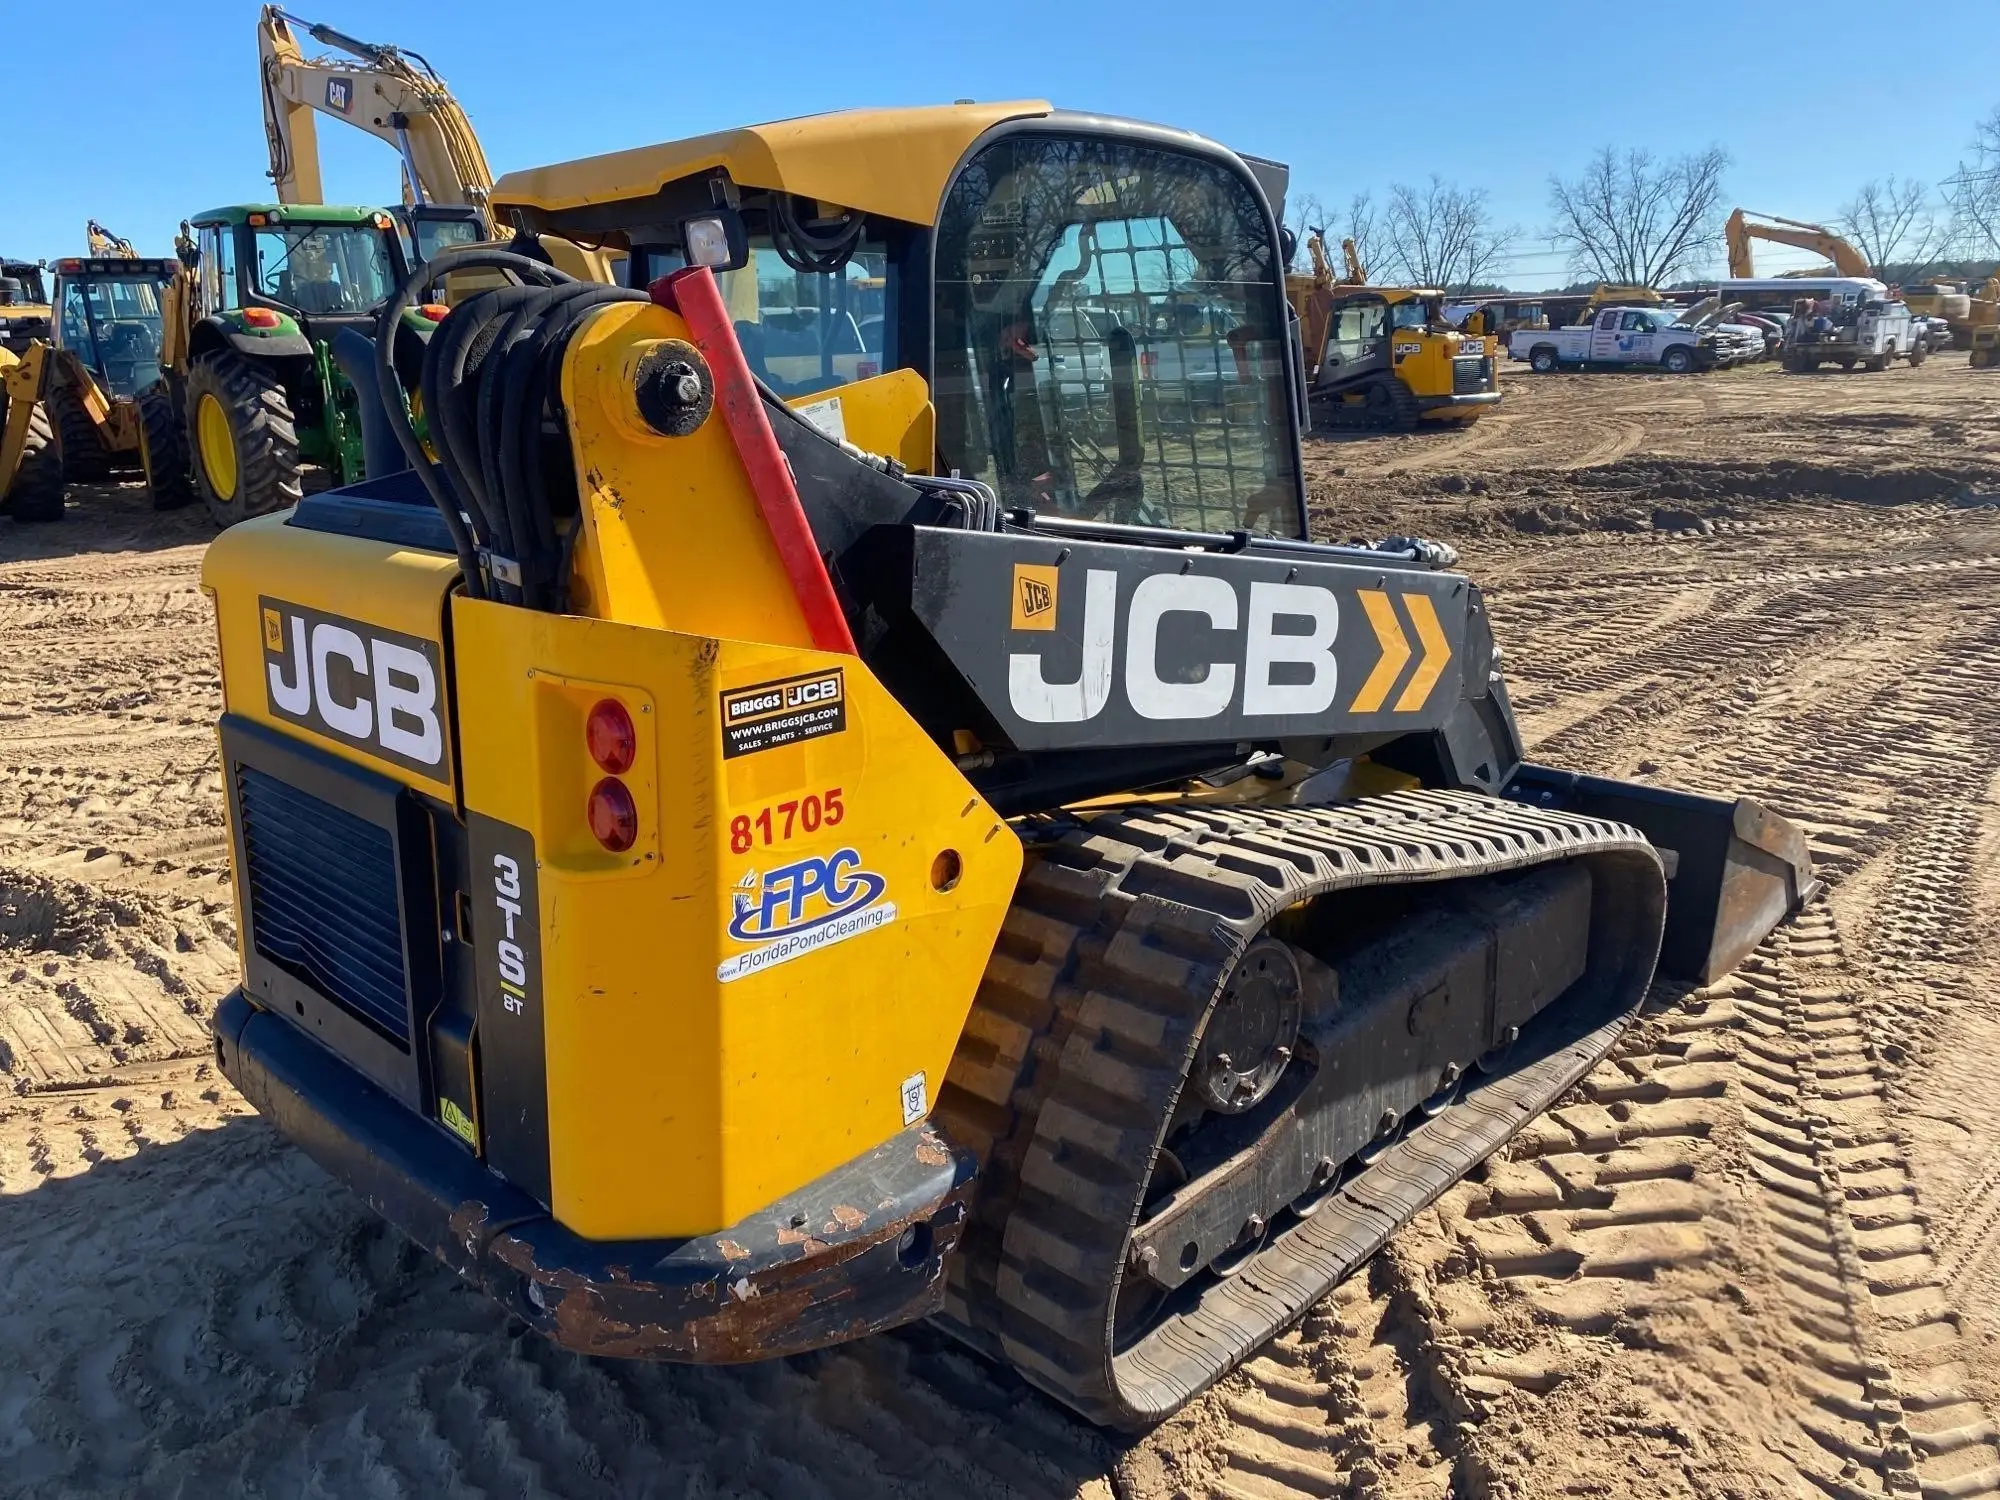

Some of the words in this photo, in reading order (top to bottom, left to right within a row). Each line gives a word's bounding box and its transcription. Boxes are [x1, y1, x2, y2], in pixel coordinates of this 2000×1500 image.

[330, 81, 346, 108] CAT
[1395, 343, 1422, 353] JCB
[1458, 341, 1485, 354] JCB
[1024, 581, 1052, 610] JCB
[1009, 568, 1339, 723] JCB
[268, 615, 442, 765] JCB
[731, 694, 781, 716] BRIGGS
[788, 679, 838, 706] JCB
[731, 707, 838, 740] WWW.BRIGGSJCB.COM
[738, 739, 762, 751] SALES
[771, 732, 795, 743] PARTS
[804, 722, 833, 735] SERVICE
[730, 787, 845, 855] 81705
[760, 848, 860, 932] FPC
[503, 993, 524, 1016] 8T
